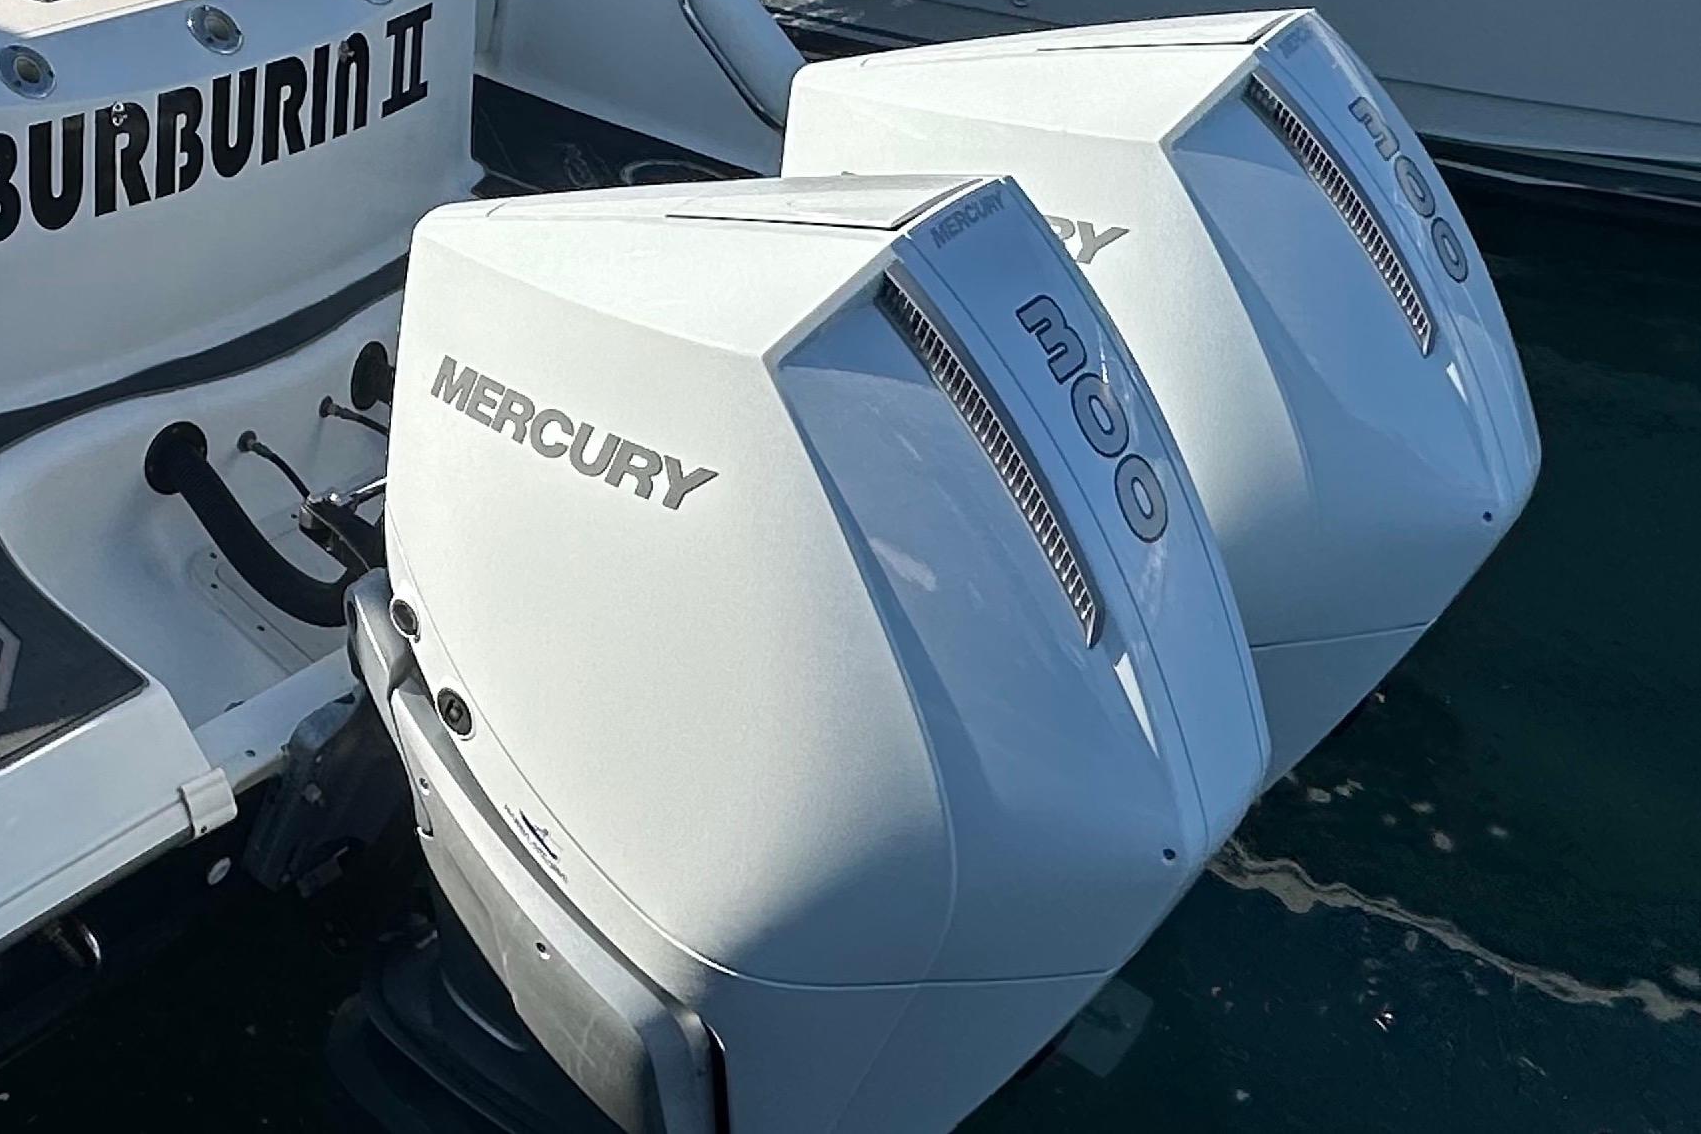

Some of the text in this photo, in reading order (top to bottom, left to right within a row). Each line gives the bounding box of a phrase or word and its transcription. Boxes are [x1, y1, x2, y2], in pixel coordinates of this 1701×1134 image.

[381, 3, 434, 119] II
[930, 189, 1006, 249] MERCURY
[1348, 96, 1469, 283] 300
[431, 354, 720, 511] MERCURY
[1016, 294, 1168, 544] 300
